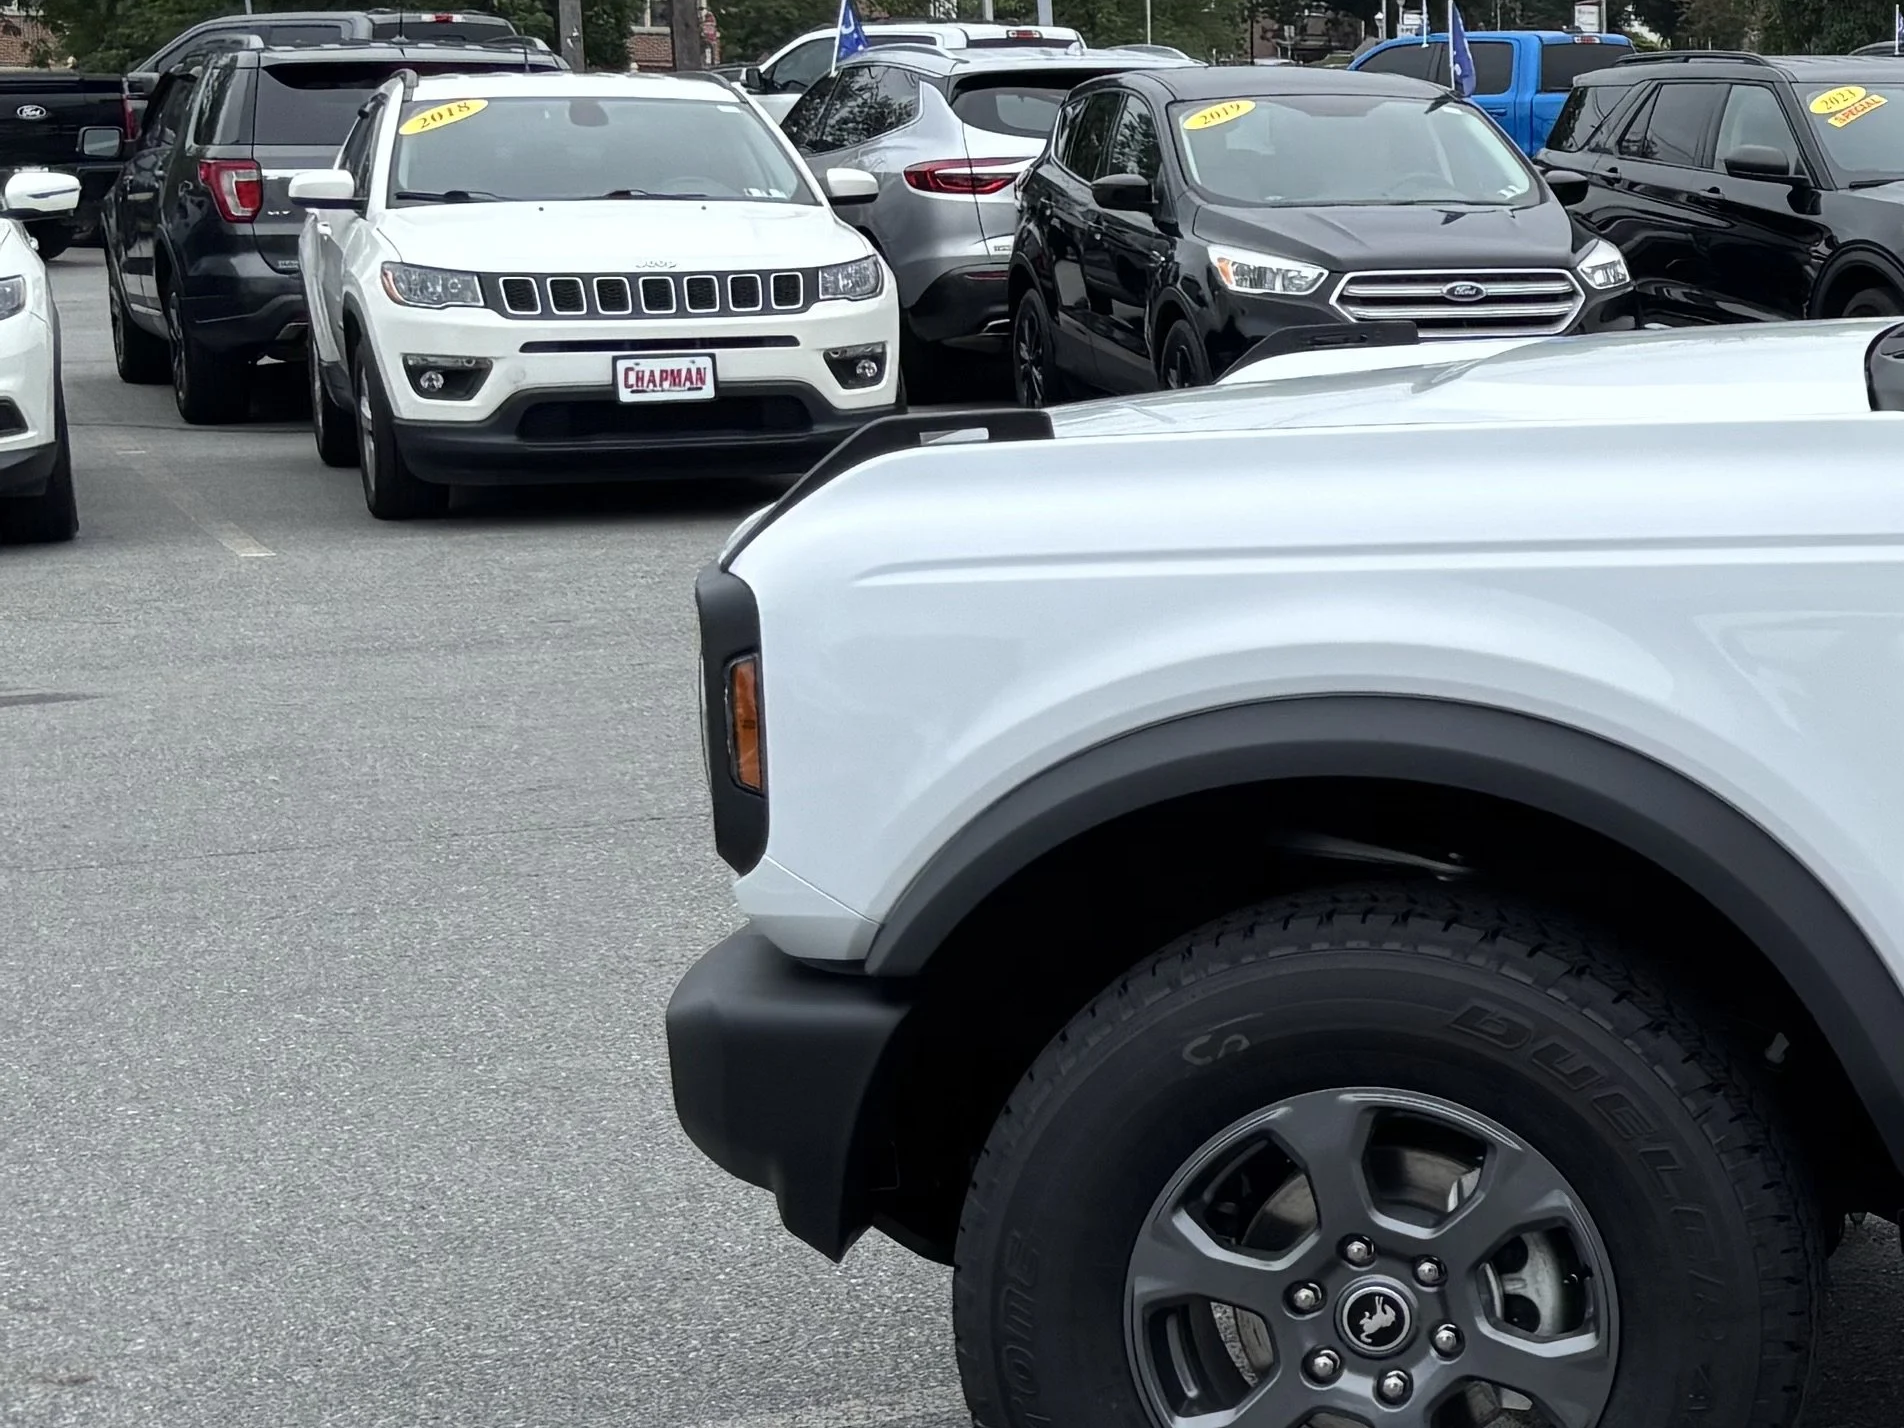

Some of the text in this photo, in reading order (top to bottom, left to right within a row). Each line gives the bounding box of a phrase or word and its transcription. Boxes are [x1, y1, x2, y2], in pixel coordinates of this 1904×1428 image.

[418, 102, 471, 129] 2018
[1200, 103, 1241, 124] 2019
[1834, 98, 1882, 124] SPECIAL
[623, 366, 707, 390] CHAPMAN
